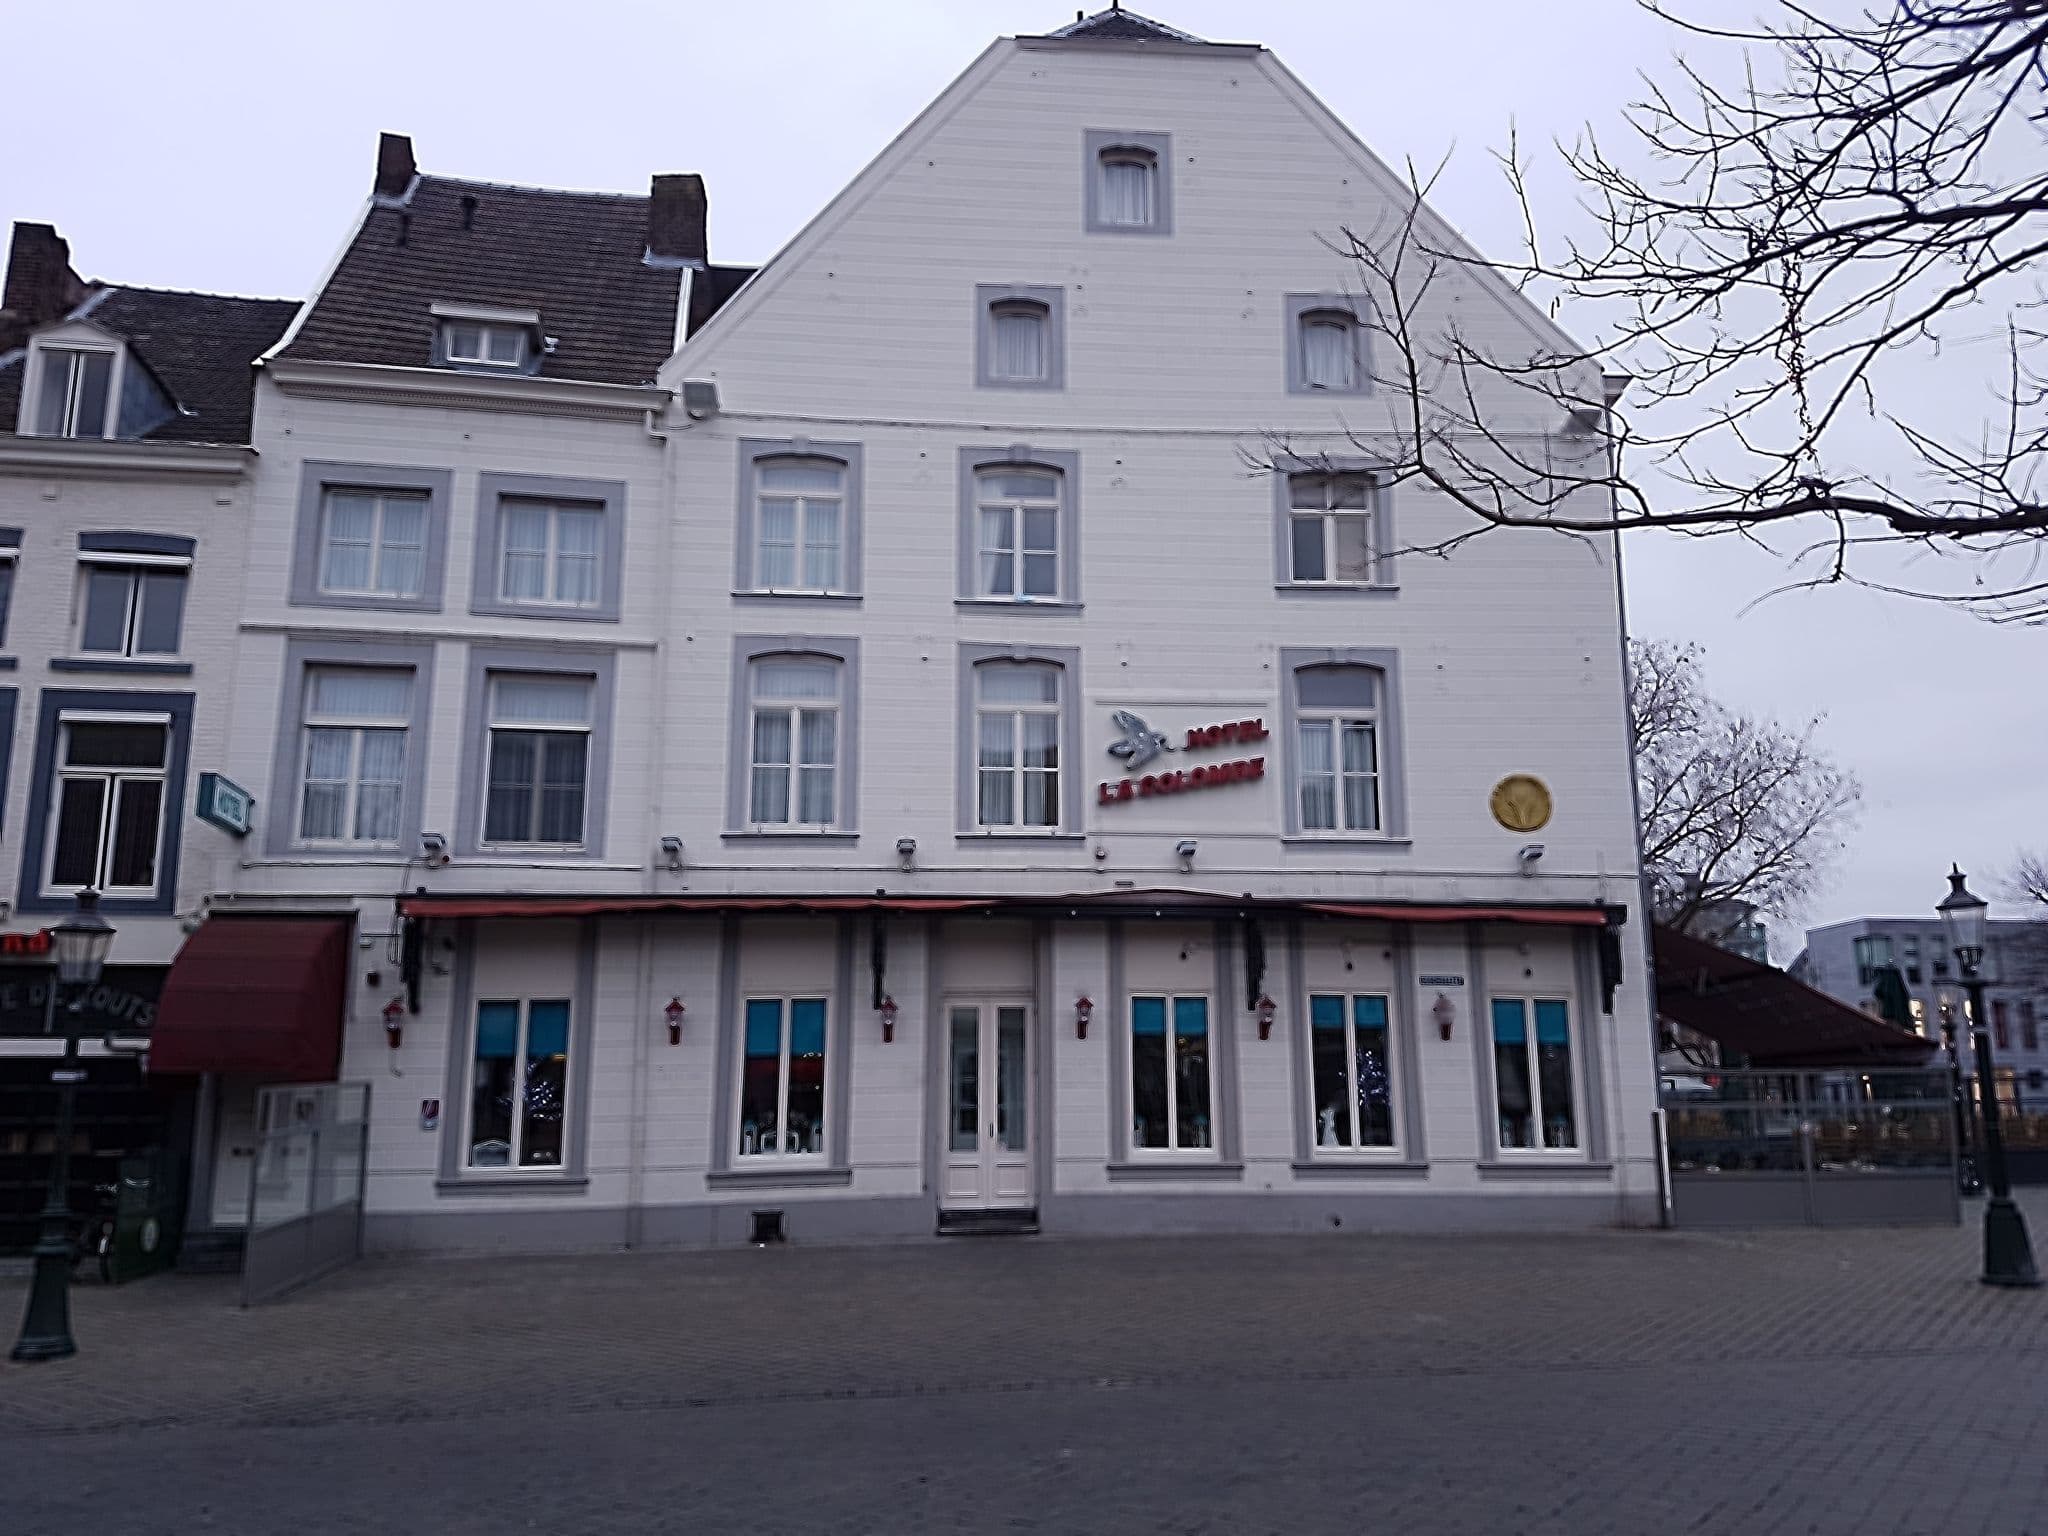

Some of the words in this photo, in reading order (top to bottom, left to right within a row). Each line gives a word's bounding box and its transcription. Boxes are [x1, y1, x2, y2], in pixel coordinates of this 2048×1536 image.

[1187, 718, 1270, 749] HOTEL
[1099, 779, 1133, 804] LA
[1139, 756, 1266, 797] COLOMBE
